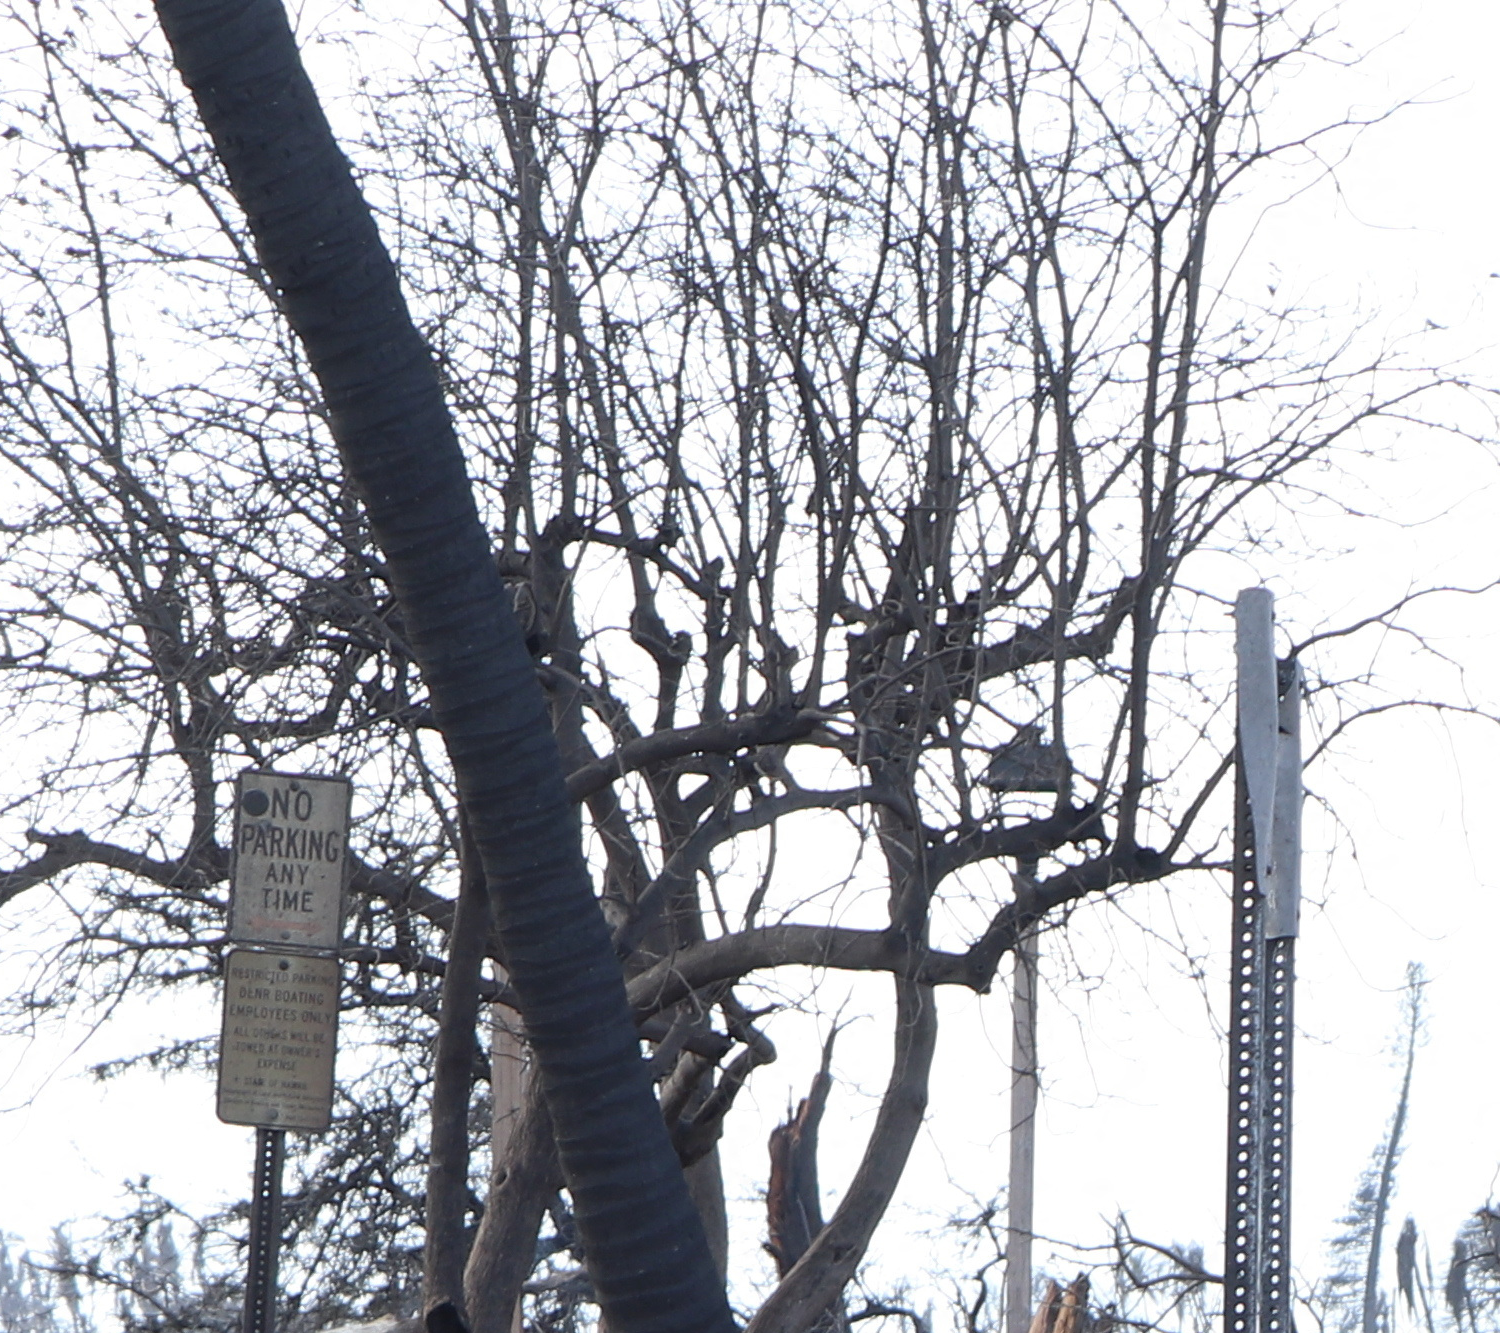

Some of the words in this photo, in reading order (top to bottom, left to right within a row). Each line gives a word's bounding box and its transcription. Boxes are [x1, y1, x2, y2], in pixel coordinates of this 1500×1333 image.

[271, 787, 313, 821] NO
[241, 823, 340, 863] PARKING
[265, 862, 309, 885] ANY
[262, 888, 314, 912] TIME
[275, 990, 324, 1005] BOATING
[229, 1004, 298, 1022] EMPLOYEES
[301, 1010, 332, 1024] ONLY
